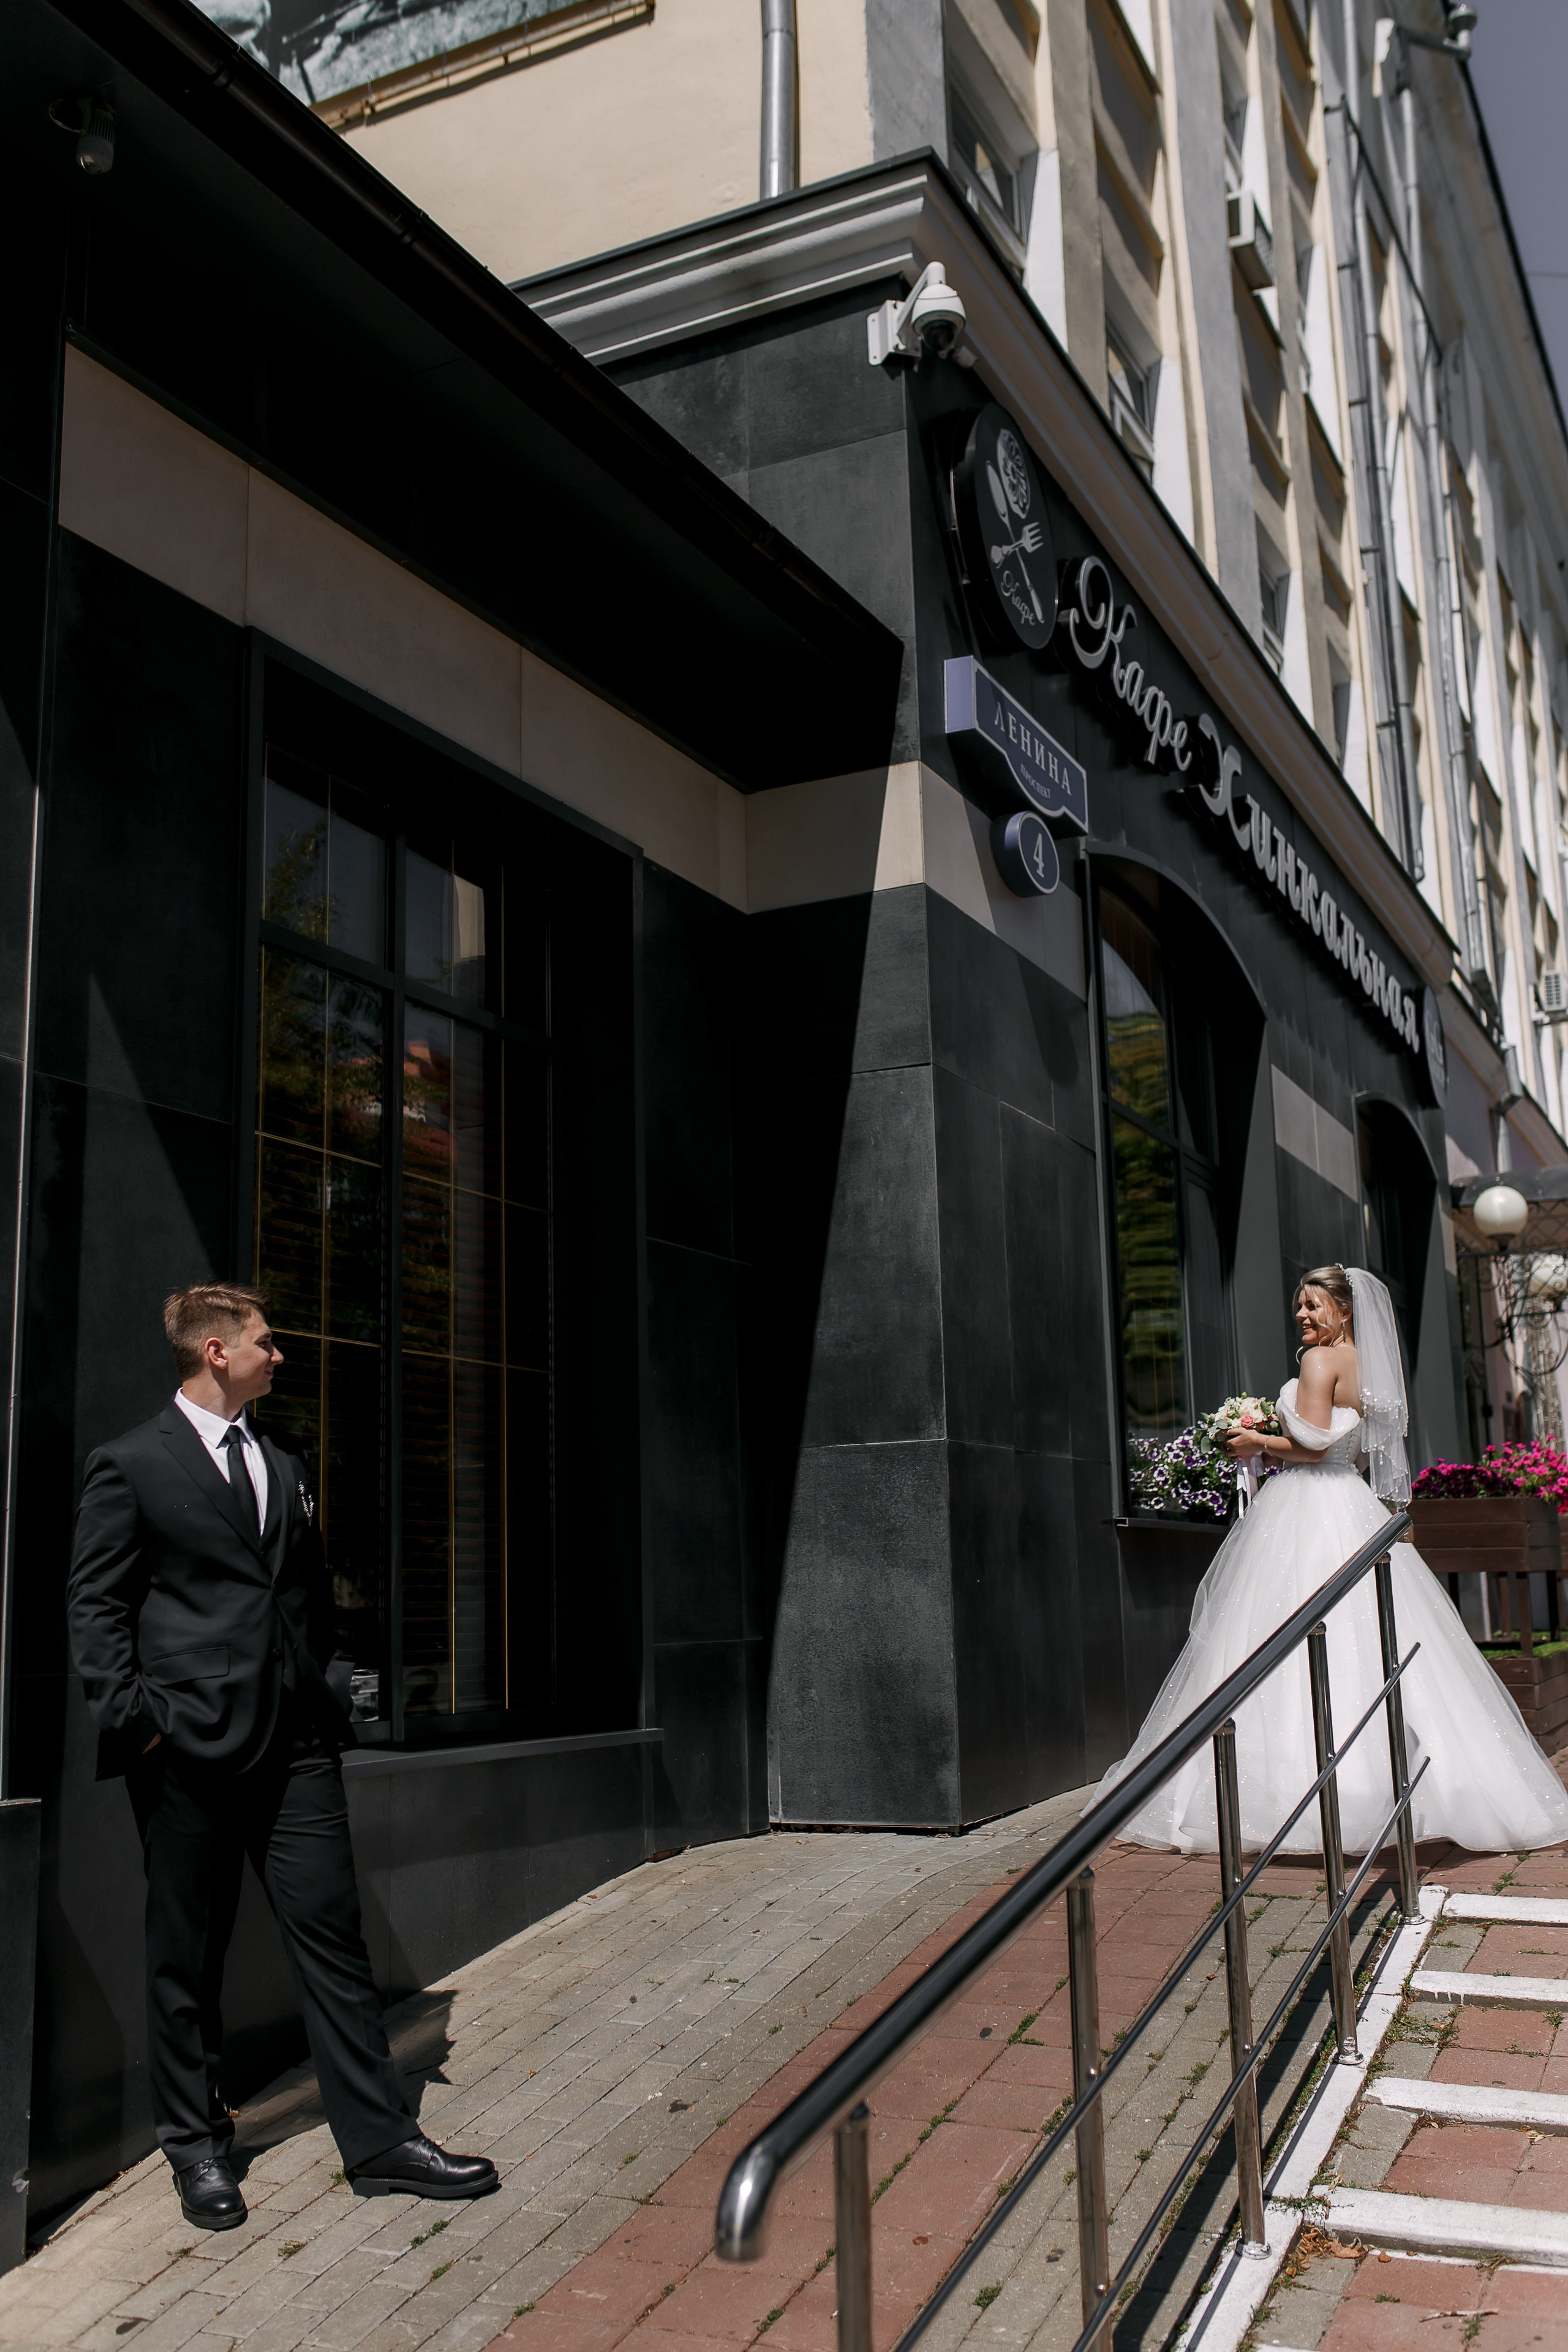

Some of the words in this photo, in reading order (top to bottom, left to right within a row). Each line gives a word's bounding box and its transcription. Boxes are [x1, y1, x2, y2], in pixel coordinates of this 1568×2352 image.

[1000, 570, 1036, 625] Кафе
[994, 701, 1072, 796] ЛЕНИНА
[1020, 763, 1051, 799] ПРОСПЕКТ
[1069, 555, 1193, 771] Кафе
[1198, 712, 1420, 1054] Хинкальная
[1033, 833, 1045, 878] 4
